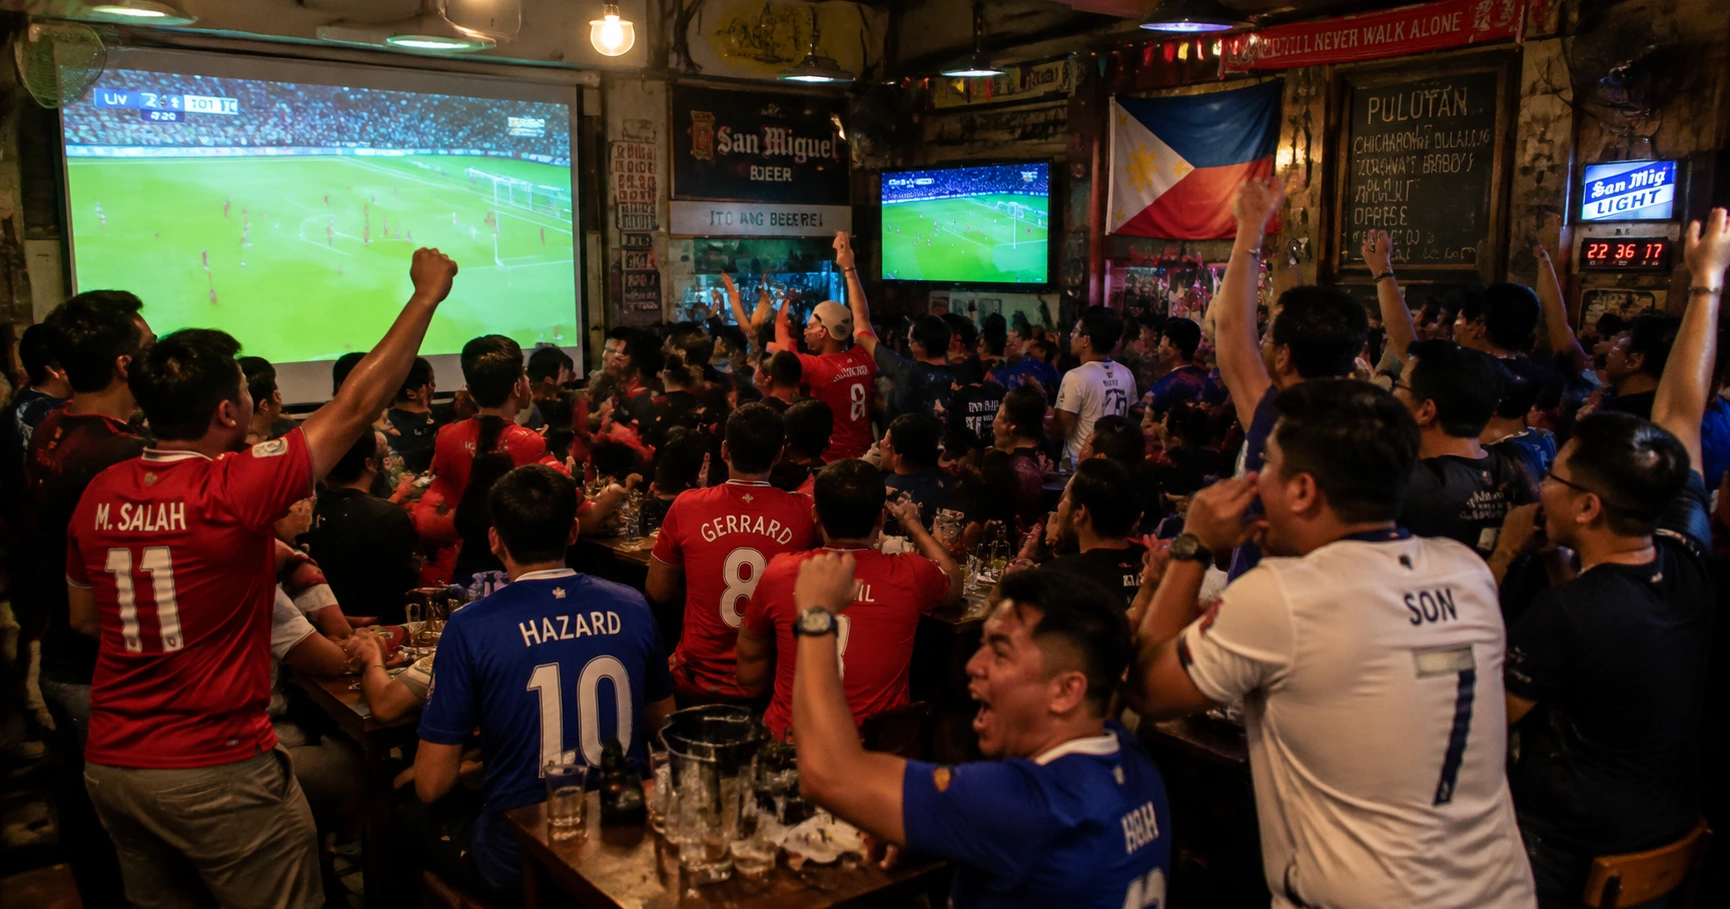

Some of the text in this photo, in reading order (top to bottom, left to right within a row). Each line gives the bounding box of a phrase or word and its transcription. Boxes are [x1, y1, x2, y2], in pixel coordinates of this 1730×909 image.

[1314, 28, 1359, 51] NEVER
[1362, 20, 1405, 46] WALK
[1411, 12, 1463, 39] ALONE
[1367, 87, 1468, 125] PULUTAN
[717, 125, 840, 164] San Miguel
[1591, 168, 1667, 199] San Mig
[1597, 188, 1662, 215] LIGHT
[1587, 243, 1663, 259] 22 36 17
[95, 502, 187, 532] M. SALAH
[700, 514, 793, 546] GERRARD
[104, 546, 184, 653] 11
[719, 546, 768, 629] 8
[1404, 588, 1458, 626] SON
[518, 611, 622, 648] HAZARD
[526, 654, 633, 779] 10
[1412, 643, 1477, 808] 7
